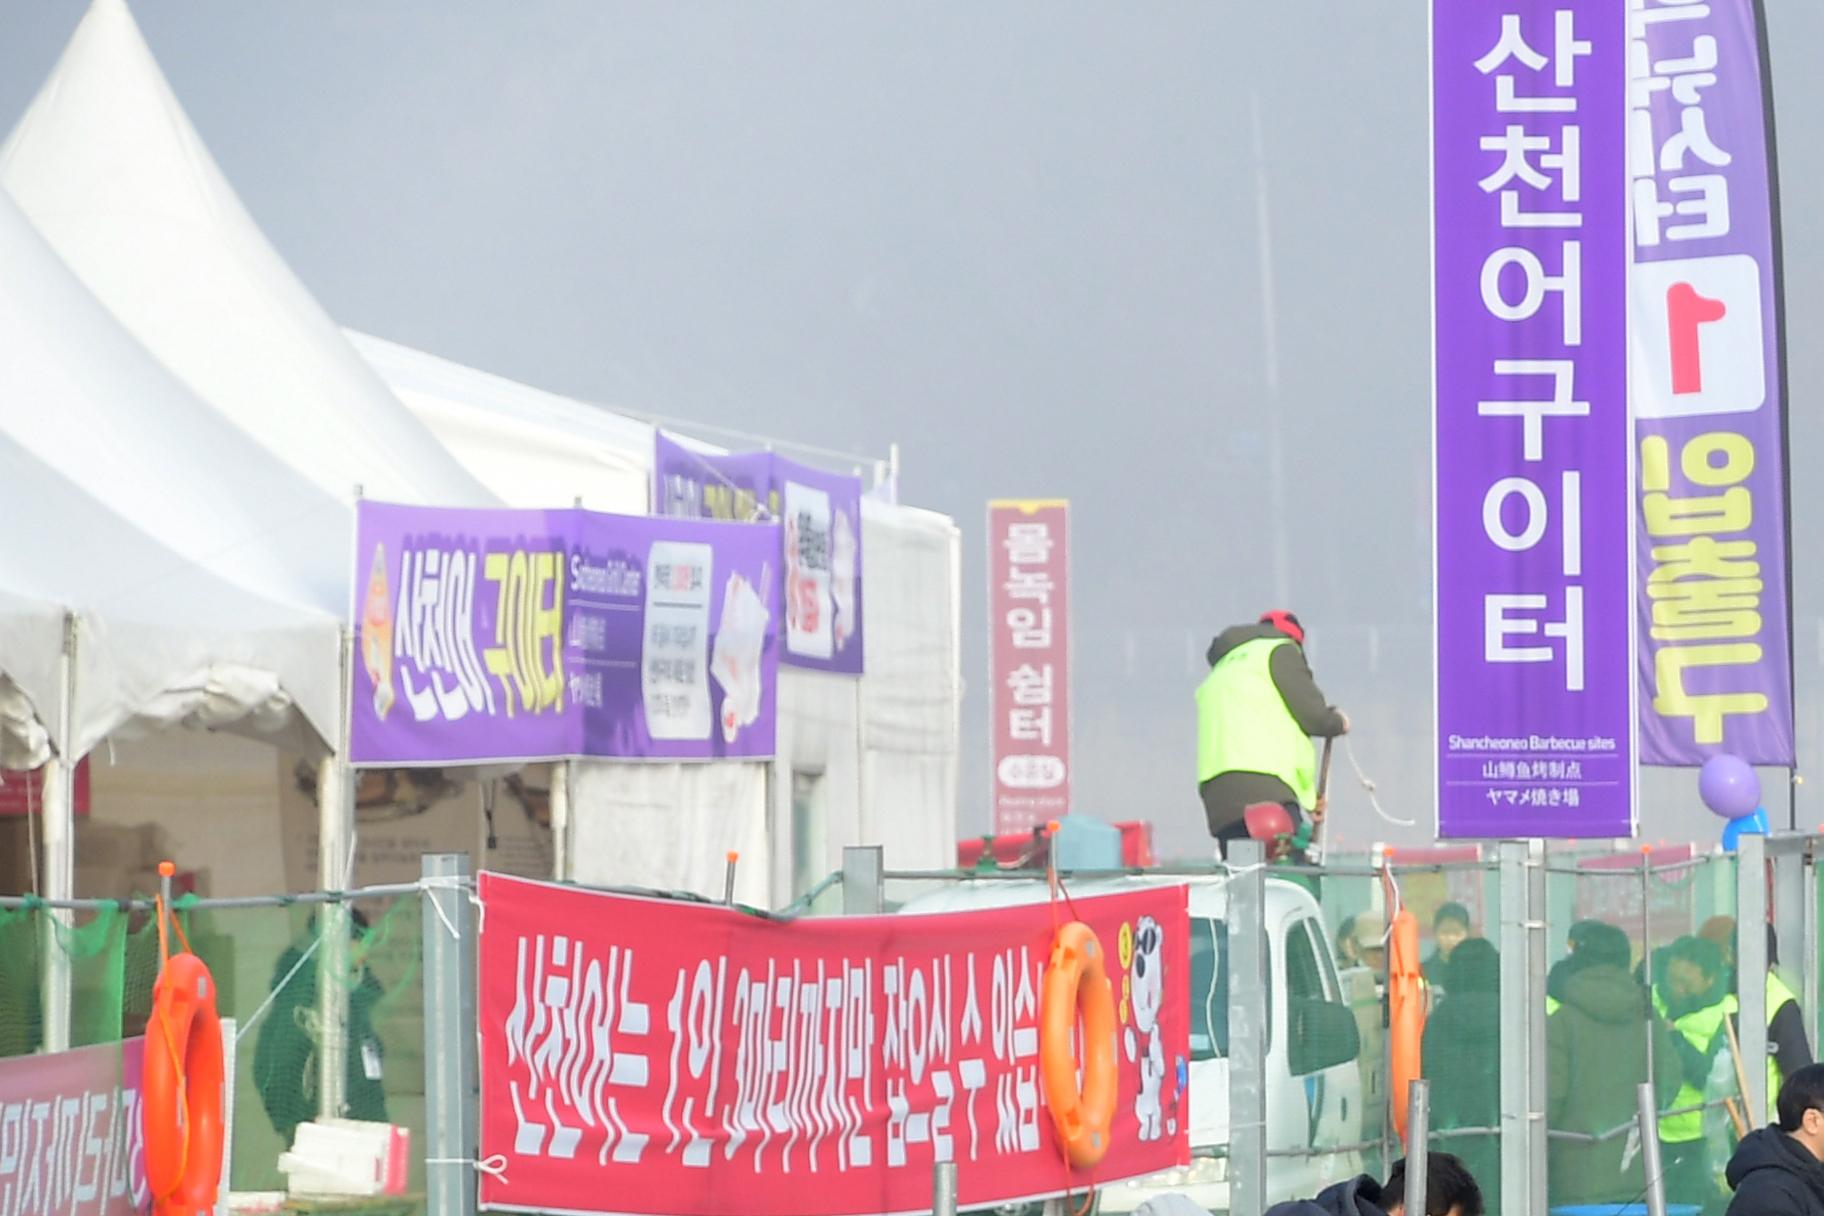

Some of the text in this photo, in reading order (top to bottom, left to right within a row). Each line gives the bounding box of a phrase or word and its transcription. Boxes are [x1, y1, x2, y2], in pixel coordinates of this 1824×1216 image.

[1473, 9, 1592, 691] 산천어구이터
[396, 549, 565, 721] 산천어 구이터
[1006, 663, 1053, 747] 쉼터
[1529, 734, 1586, 750] Barbecue
[1587, 735, 1616, 750] sites
[505, 934, 650, 1165] 산천어는
[883, 953, 954, 1169] 잡으실
[959, 952, 986, 1161] 수
